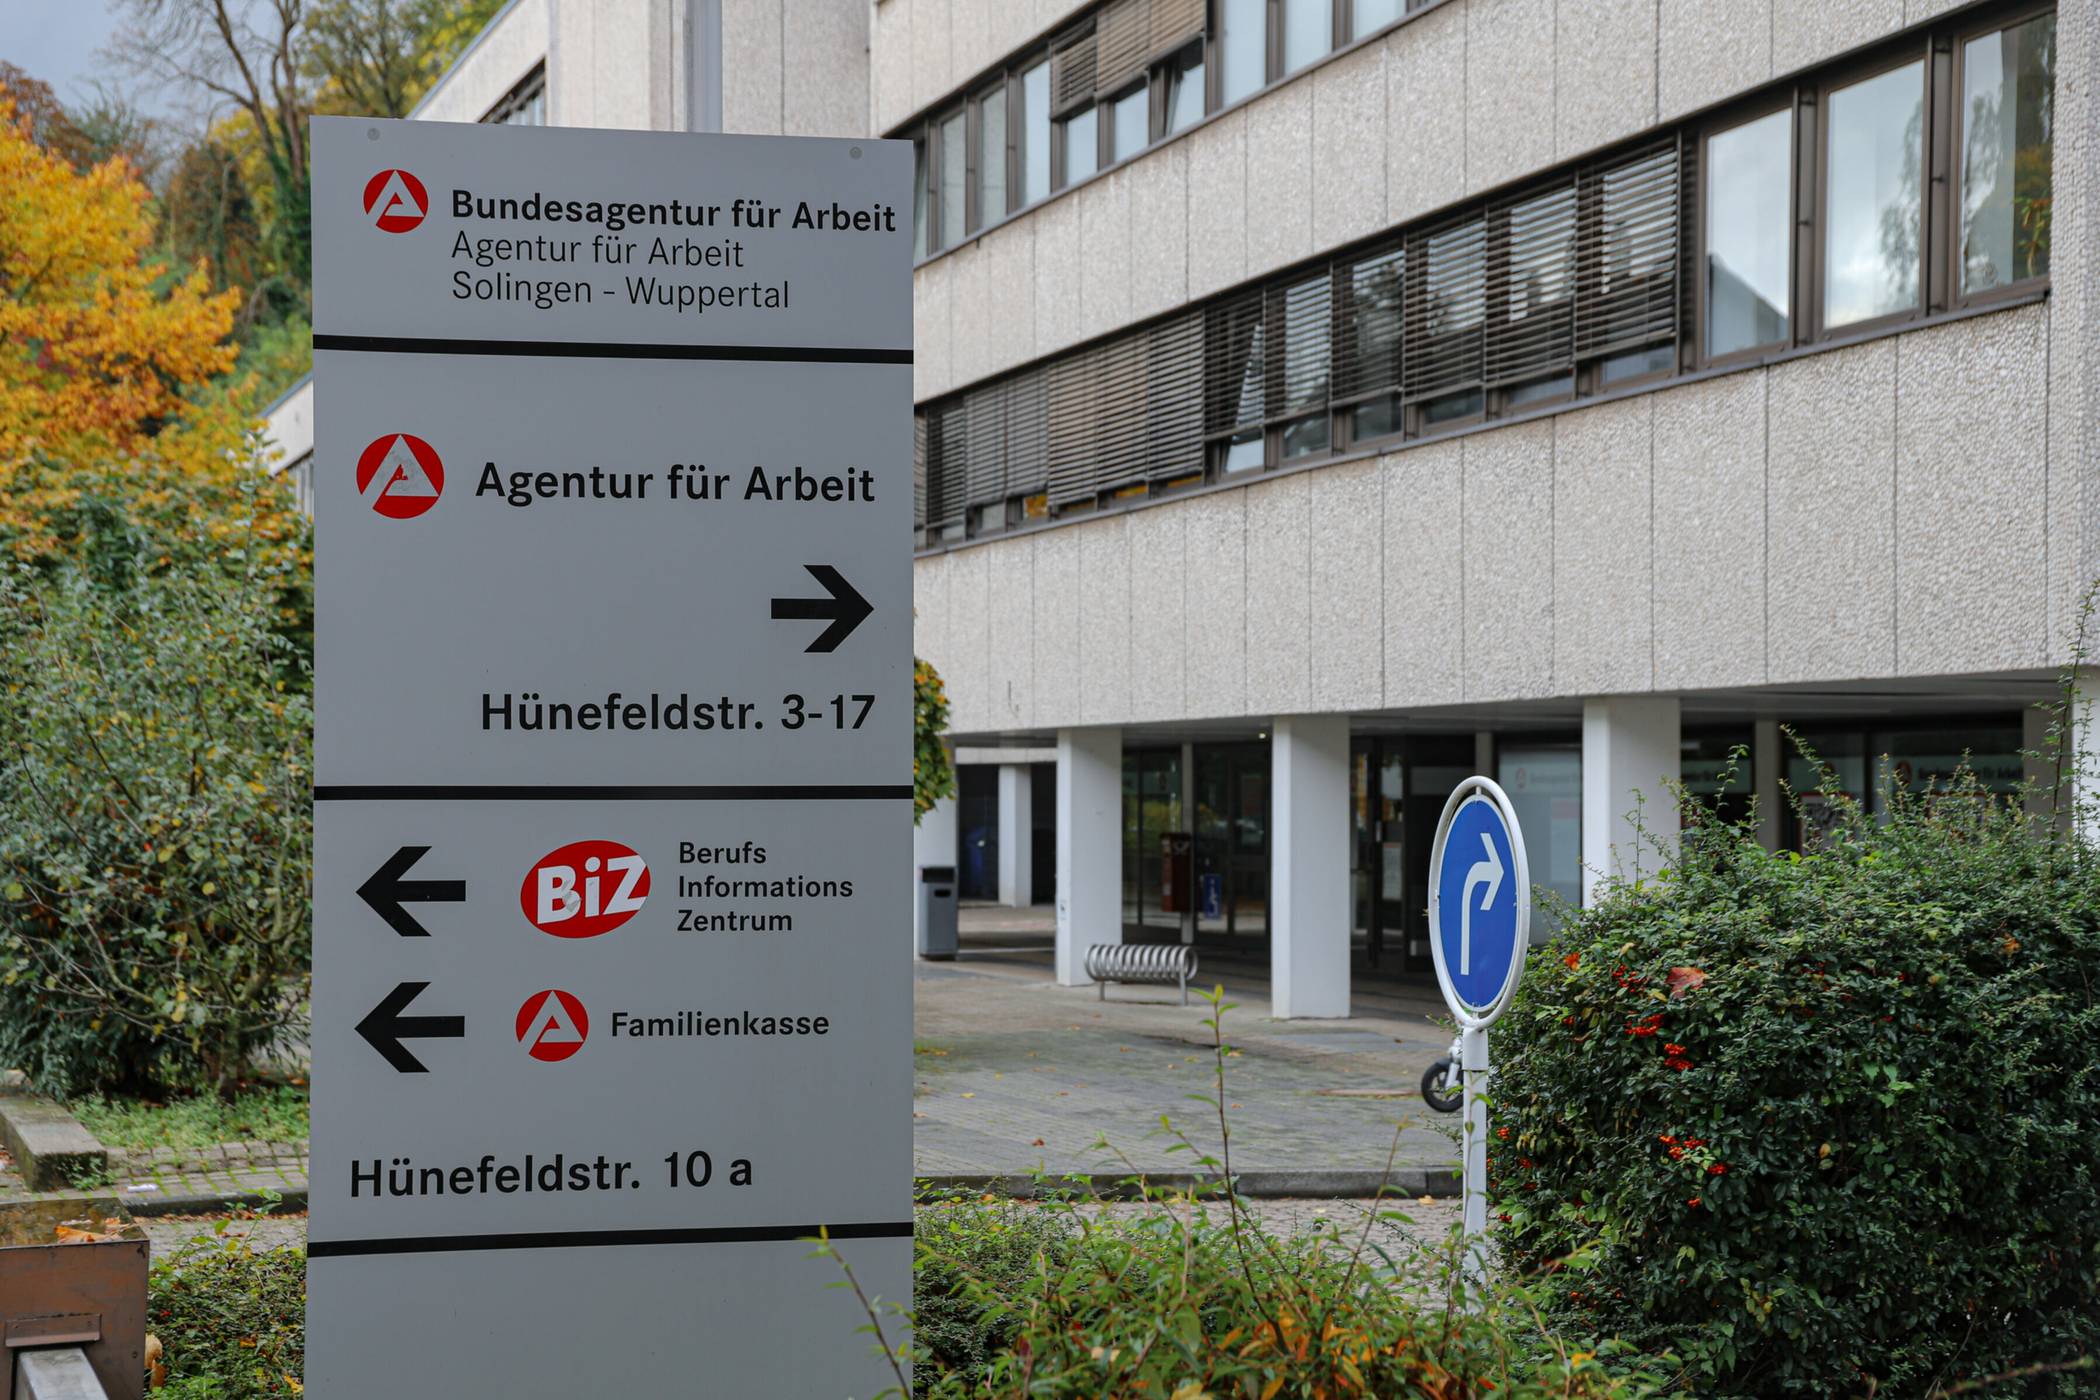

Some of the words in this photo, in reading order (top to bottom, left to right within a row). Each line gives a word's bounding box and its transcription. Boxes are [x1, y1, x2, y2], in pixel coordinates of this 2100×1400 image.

[452, 189, 721, 232] Bundesagentur
[731, 198, 782, 229] für
[791, 201, 896, 233] Arbeit
[451, 230, 582, 268] Agentur
[591, 234, 638, 264] für
[647, 236, 744, 268] Arbeit
[452, 270, 591, 310] Solingen
[625, 276, 789, 314] Wuppertal
[475, 461, 654, 508] Agentur
[667, 463, 730, 500] für
[743, 465, 875, 502] Arbeit
[482, 692, 764, 731] Hünefeldstr.
[780, 693, 876, 730] 3-17
[679, 840, 767, 864] Berufs
[537, 854, 649, 925] BiZ
[679, 874, 853, 898] Informations
[676, 909, 792, 932] Zentrum
[611, 1010, 830, 1037] Familienkasse
[351, 1153, 641, 1198] Hünefeldstr.
[664, 1150, 713, 1188] 10
[729, 1158, 753, 1187] a
